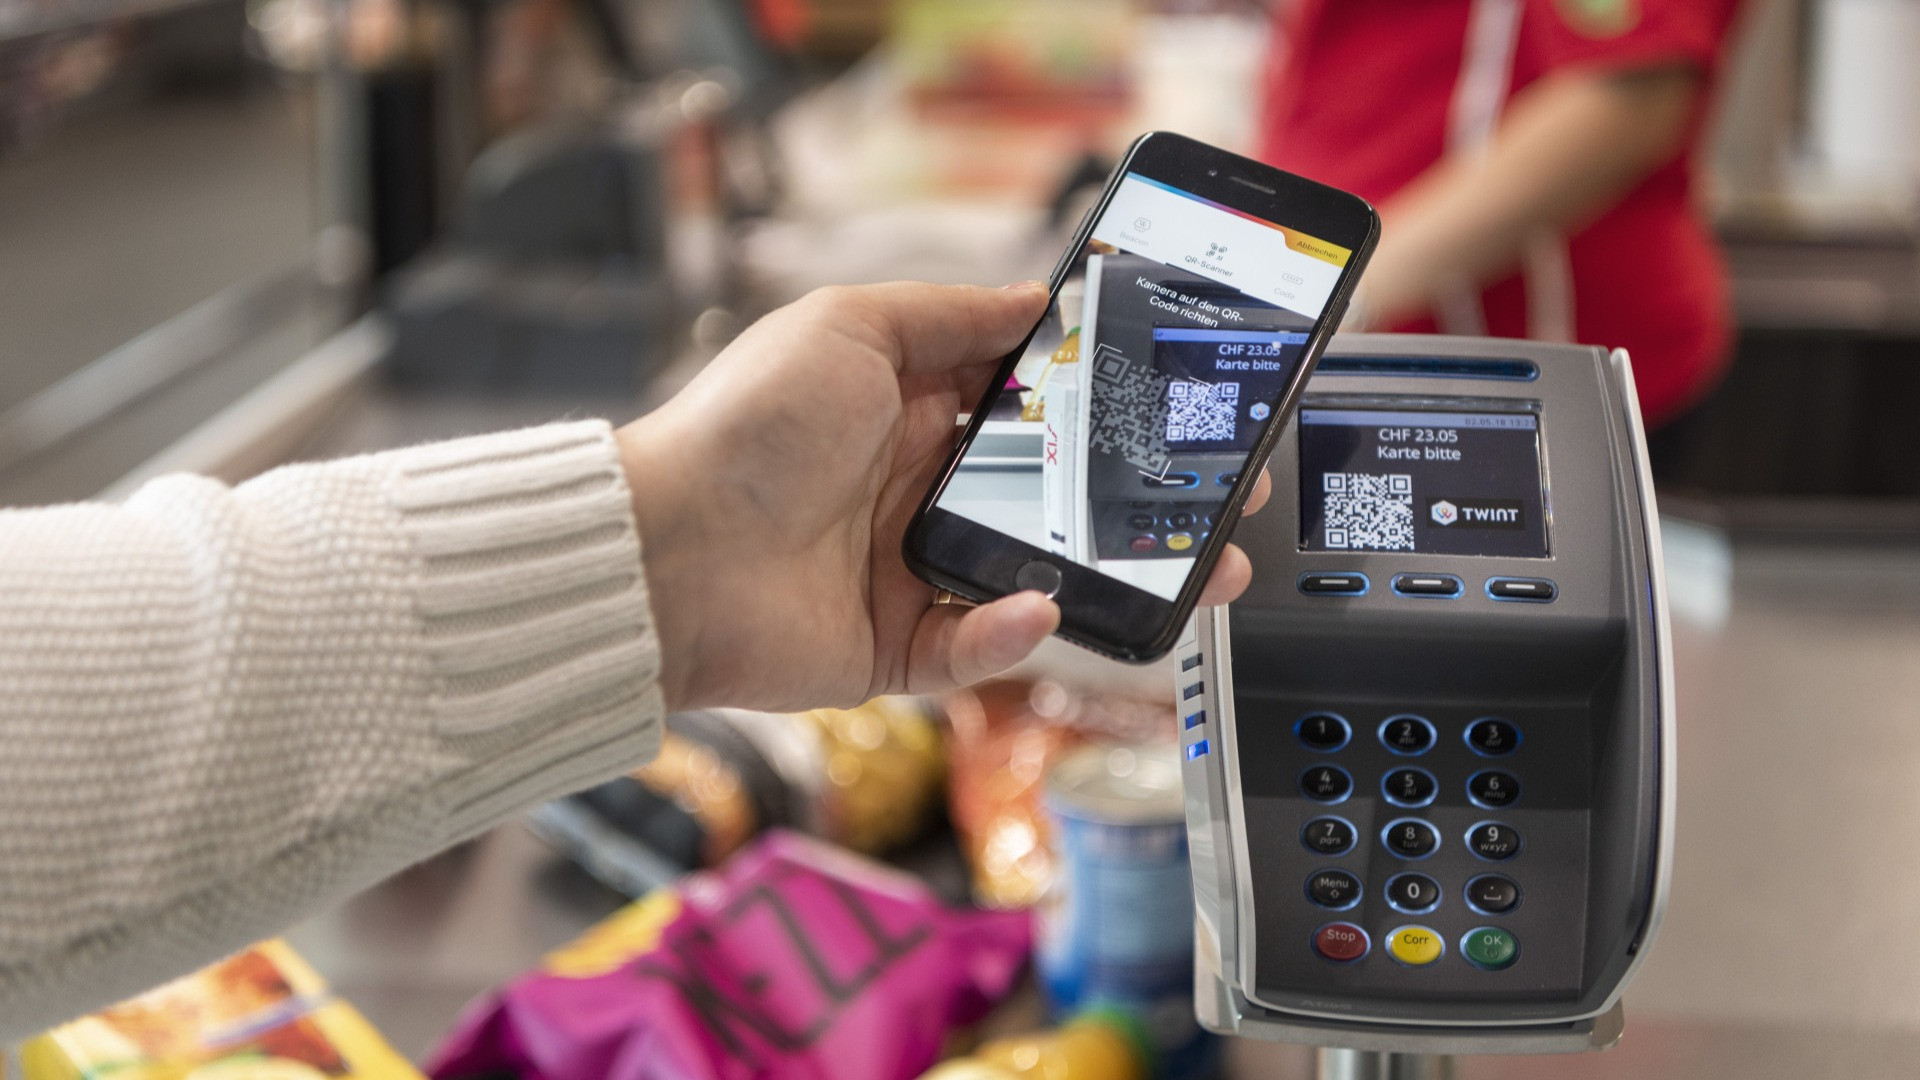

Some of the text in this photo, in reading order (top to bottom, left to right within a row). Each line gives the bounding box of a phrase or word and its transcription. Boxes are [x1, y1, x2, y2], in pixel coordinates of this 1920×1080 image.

[1296, 240, 1338, 260] Abbrechen
[1184, 255, 1234, 278] QR-Scanner
[1136, 276, 1244, 323] Kamera auf den QR-
[1273, 287, 1296, 301] Code
[1149, 295, 1219, 329] Code richten
[1218, 344, 1281, 357] CHF 23.05
[1215, 359, 1281, 371] Karte bitte
[1378, 428, 1458, 443] CHF 23.05
[1377, 446, 1462, 461] Karte bitte
[1462, 507, 1519, 522] TWINT
[1318, 721, 1326, 734] 1
[1402, 723, 1412, 736] 2
[1488, 725, 1498, 738] 3
[1320, 771, 1331, 783] 4
[1404, 774, 1414, 787] 5
[1489, 777, 1499, 790] 6
[1324, 823, 1335, 836] 7
[1405, 827, 1415, 839] 8
[1488, 827, 1499, 841] 9
[1480, 842, 1508, 852] wxyz
[1320, 877, 1349, 889] Menu
[1407, 883, 1420, 899] 0
[1326, 929, 1356, 942] Stop
[1403, 934, 1429, 945] Corr
[1483, 935, 1503, 946] OK
